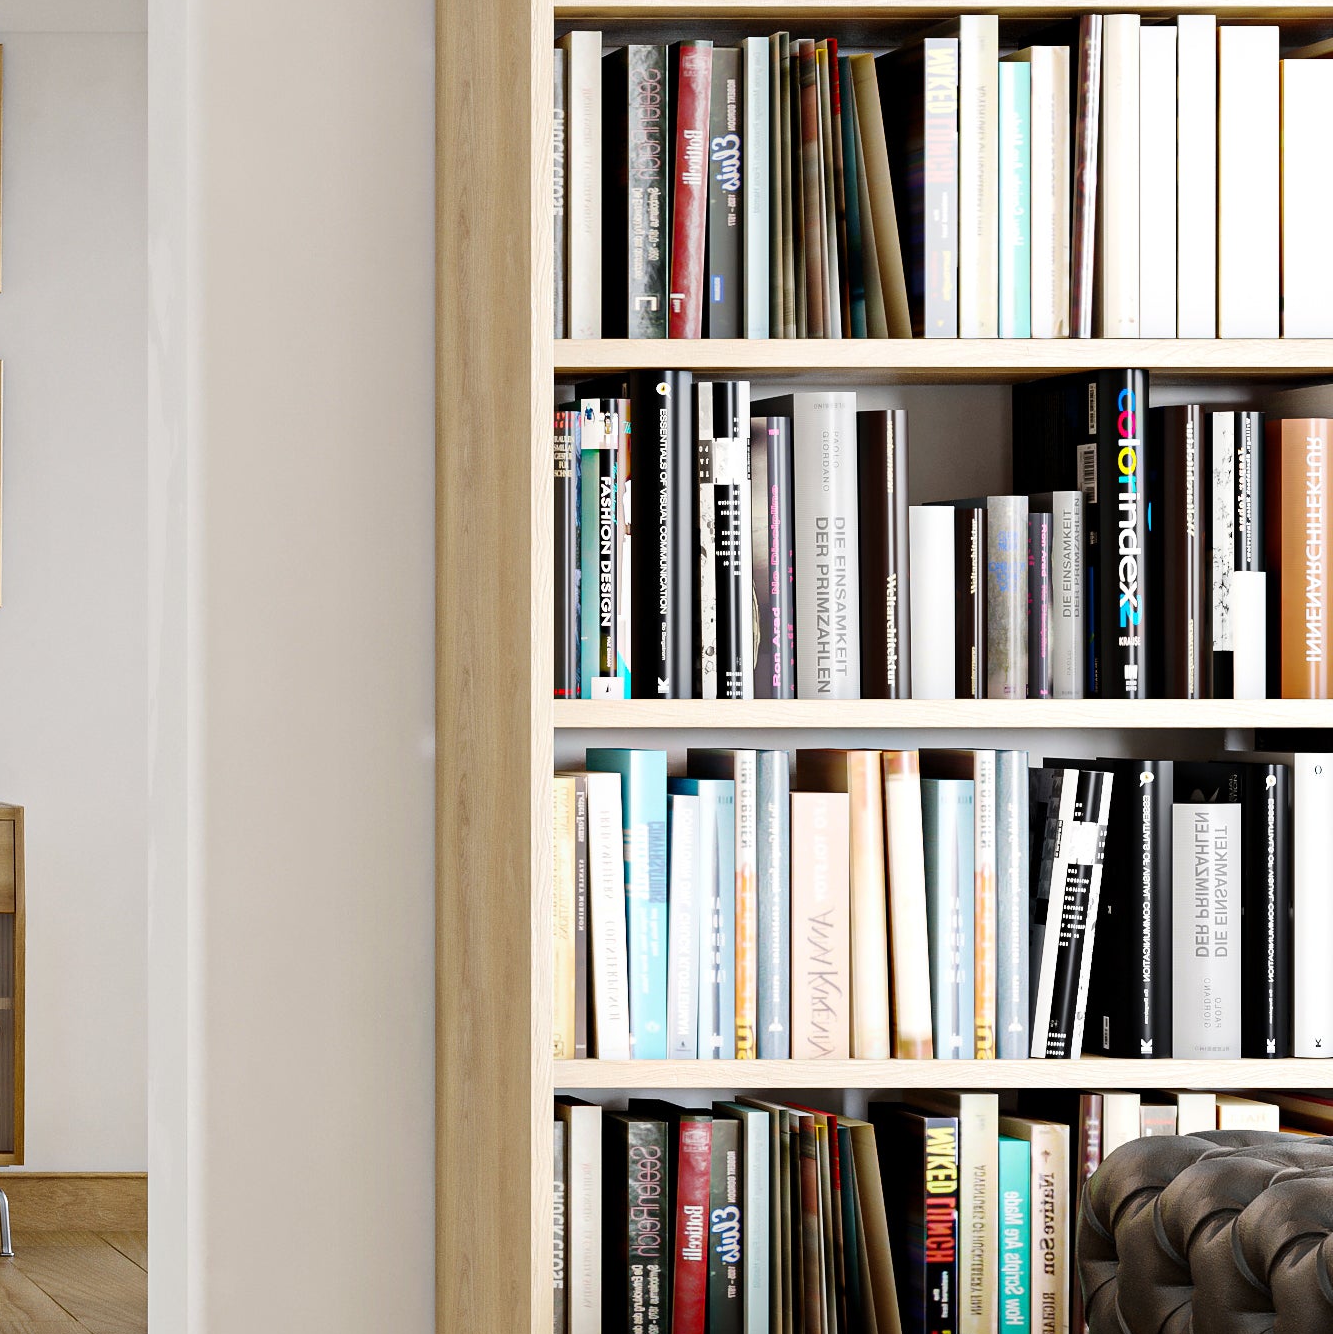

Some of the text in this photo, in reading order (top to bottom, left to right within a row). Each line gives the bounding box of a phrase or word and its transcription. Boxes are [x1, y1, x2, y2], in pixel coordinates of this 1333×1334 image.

[821, 430, 830, 493] GIORDANO
[600, 475, 611, 555] FASHION
[659, 407, 668, 615] ESSENTIALS OF VISUAL COMMUNICATION
[1117, 387, 1142, 628] colorindex2
[600, 560, 612, 627] DESIGN
[771, 570, 781, 595] No
[833, 515, 848, 678] DIE EINSAMKEIT
[1062, 508, 1071, 618] DIE EINSAMKEIT
[771, 607, 781, 647] Arad
[815, 515, 831, 694] DER PRIMZAHLEN
[886, 572, 896, 687] Weltarchitektur
[1118, 635, 1141, 647] KRAUSE
[771, 650, 781, 687] Ron
